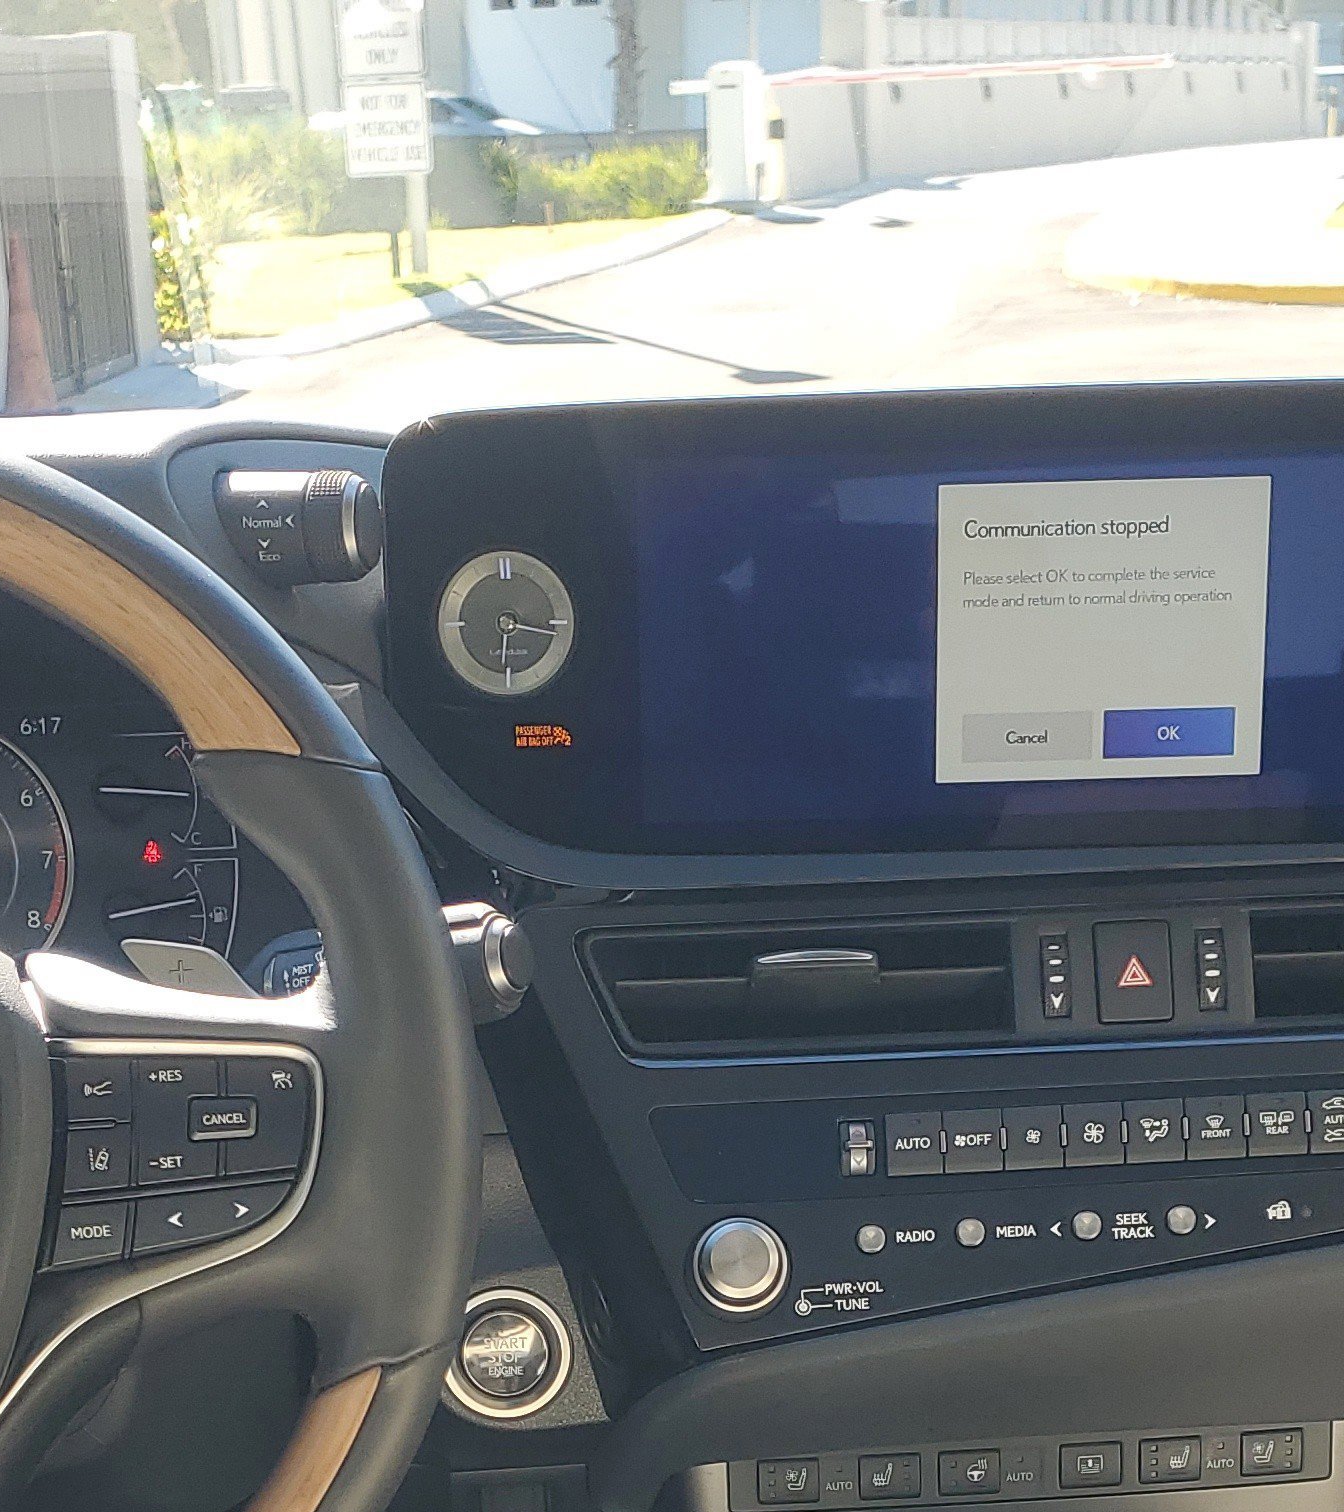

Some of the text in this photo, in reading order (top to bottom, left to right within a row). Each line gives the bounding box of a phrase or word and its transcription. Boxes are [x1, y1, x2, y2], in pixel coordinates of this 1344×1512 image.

[241, 514, 283, 530] Normal
[963, 515, 1170, 539] Communication stopped
[258, 550, 282, 562] Eco
[963, 565, 1216, 586] Please select OK to complete the service
[962, 588, 1233, 609] mode and return to normal driving operation
[20, 717, 61, 735] 6:17
[515, 725, 552, 736] PASSENGER
[1156, 725, 1181, 741] OK
[181, 737, 192, 751] H
[516, 735, 554, 747] AIR BAG OFF
[1005, 729, 1048, 745] Cancel
[20, 789, 33, 807] 6
[190, 832, 201, 846] C
[42, 851, 53, 869] 7
[194, 864, 203, 879] F
[27, 910, 41, 928] 8
[292, 963, 314, 976] MIST
[292, 976, 311, 988] OFF
[202, 1112, 247, 1126] CANCEL
[1201, 1128, 1231, 1140] FRONT
[1266, 1125, 1289, 1135] REAR
[895, 1137, 931, 1150] AUTO
[966, 1133, 992, 1146] OFF
[1115, 1212, 1148, 1226] SEEK
[70, 1224, 112, 1239] MODE
[895, 1229, 935, 1244] RADIO
[995, 1224, 1037, 1239] MEDIA
[1111, 1225, 1155, 1240] TRACK
[834, 1297, 870, 1311] TUNE
[484, 1336, 528, 1349] START
[488, 1352, 522, 1363] STOP
[488, 1365, 524, 1376] ENGINE
[1206, 1456, 1235, 1469] AUTO
[1005, 1470, 1034, 1483] AUTO
[825, 1480, 854, 1493] AUTO
